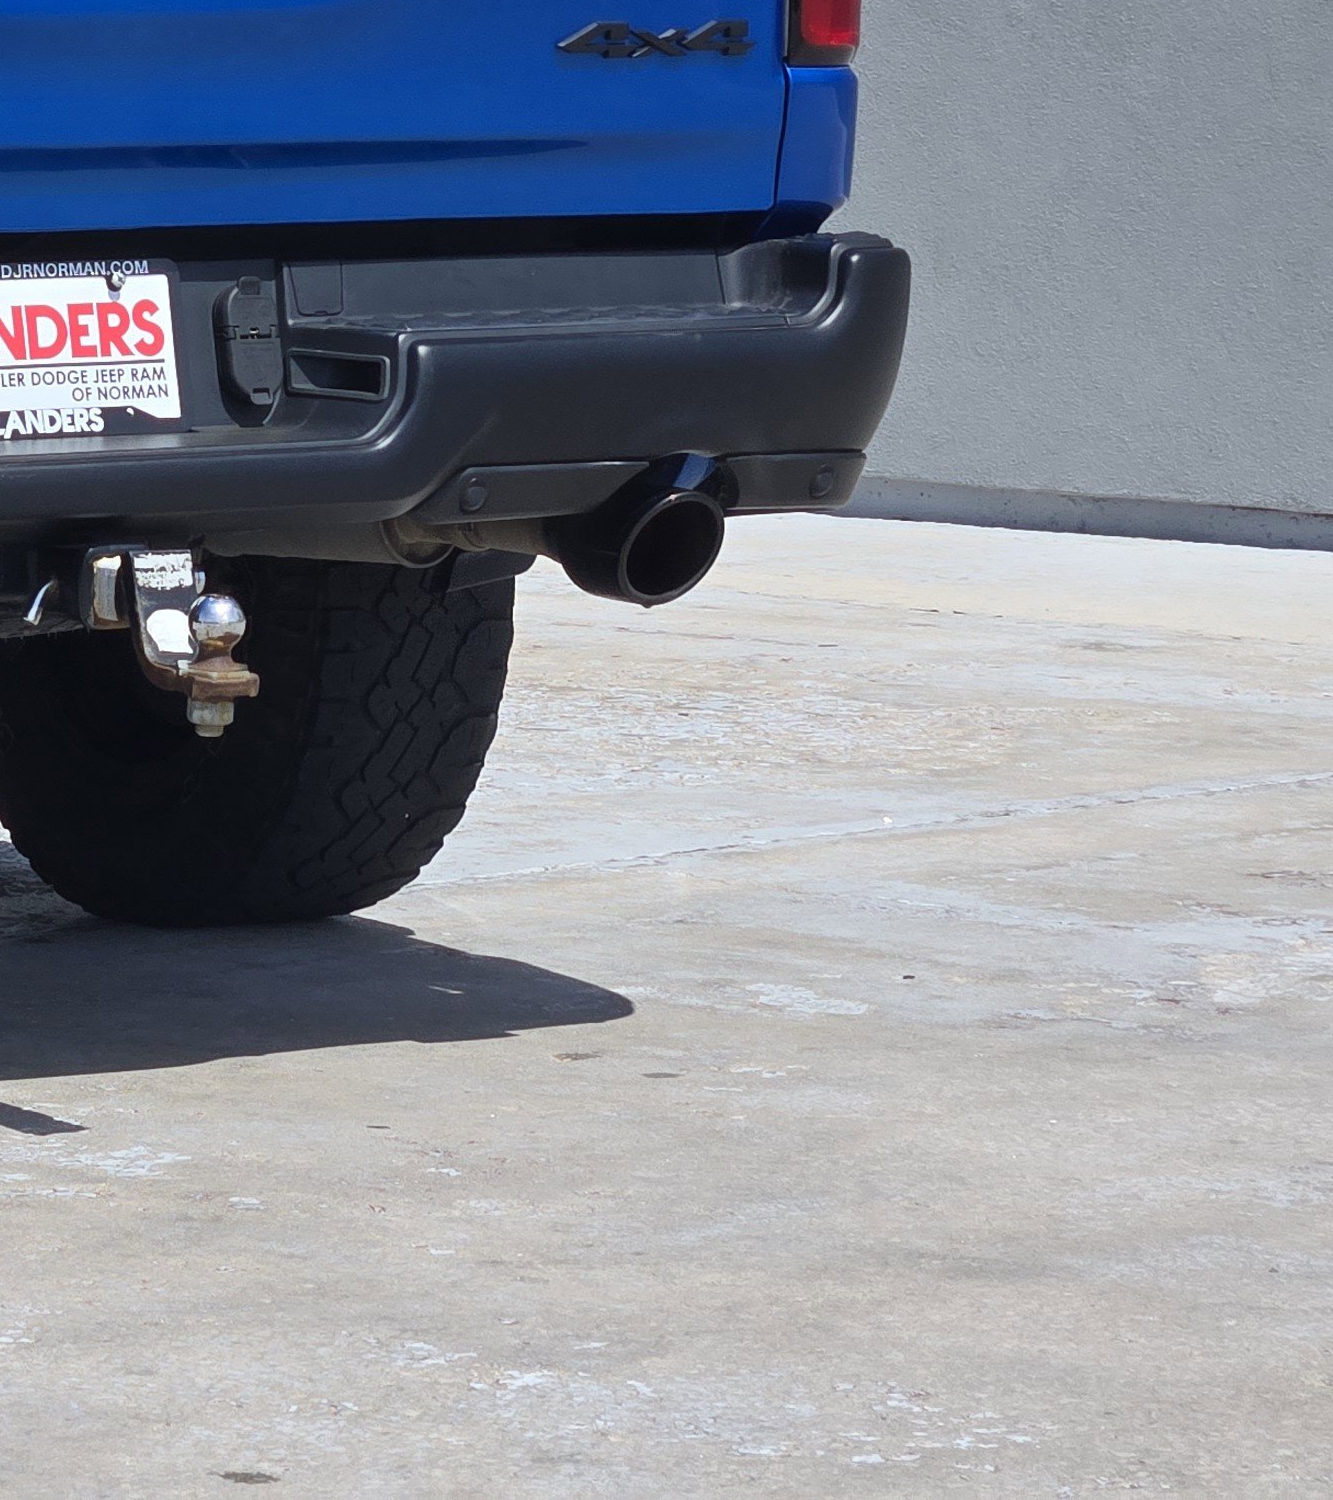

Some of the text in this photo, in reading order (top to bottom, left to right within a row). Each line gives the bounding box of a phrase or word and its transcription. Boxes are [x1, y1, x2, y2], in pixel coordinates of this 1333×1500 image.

[32, 369, 89, 387] DODGE
[93, 368, 125, 384] JEEP
[131, 367, 167, 381] RAM
[71, 384, 169, 402] OF NORMAN
